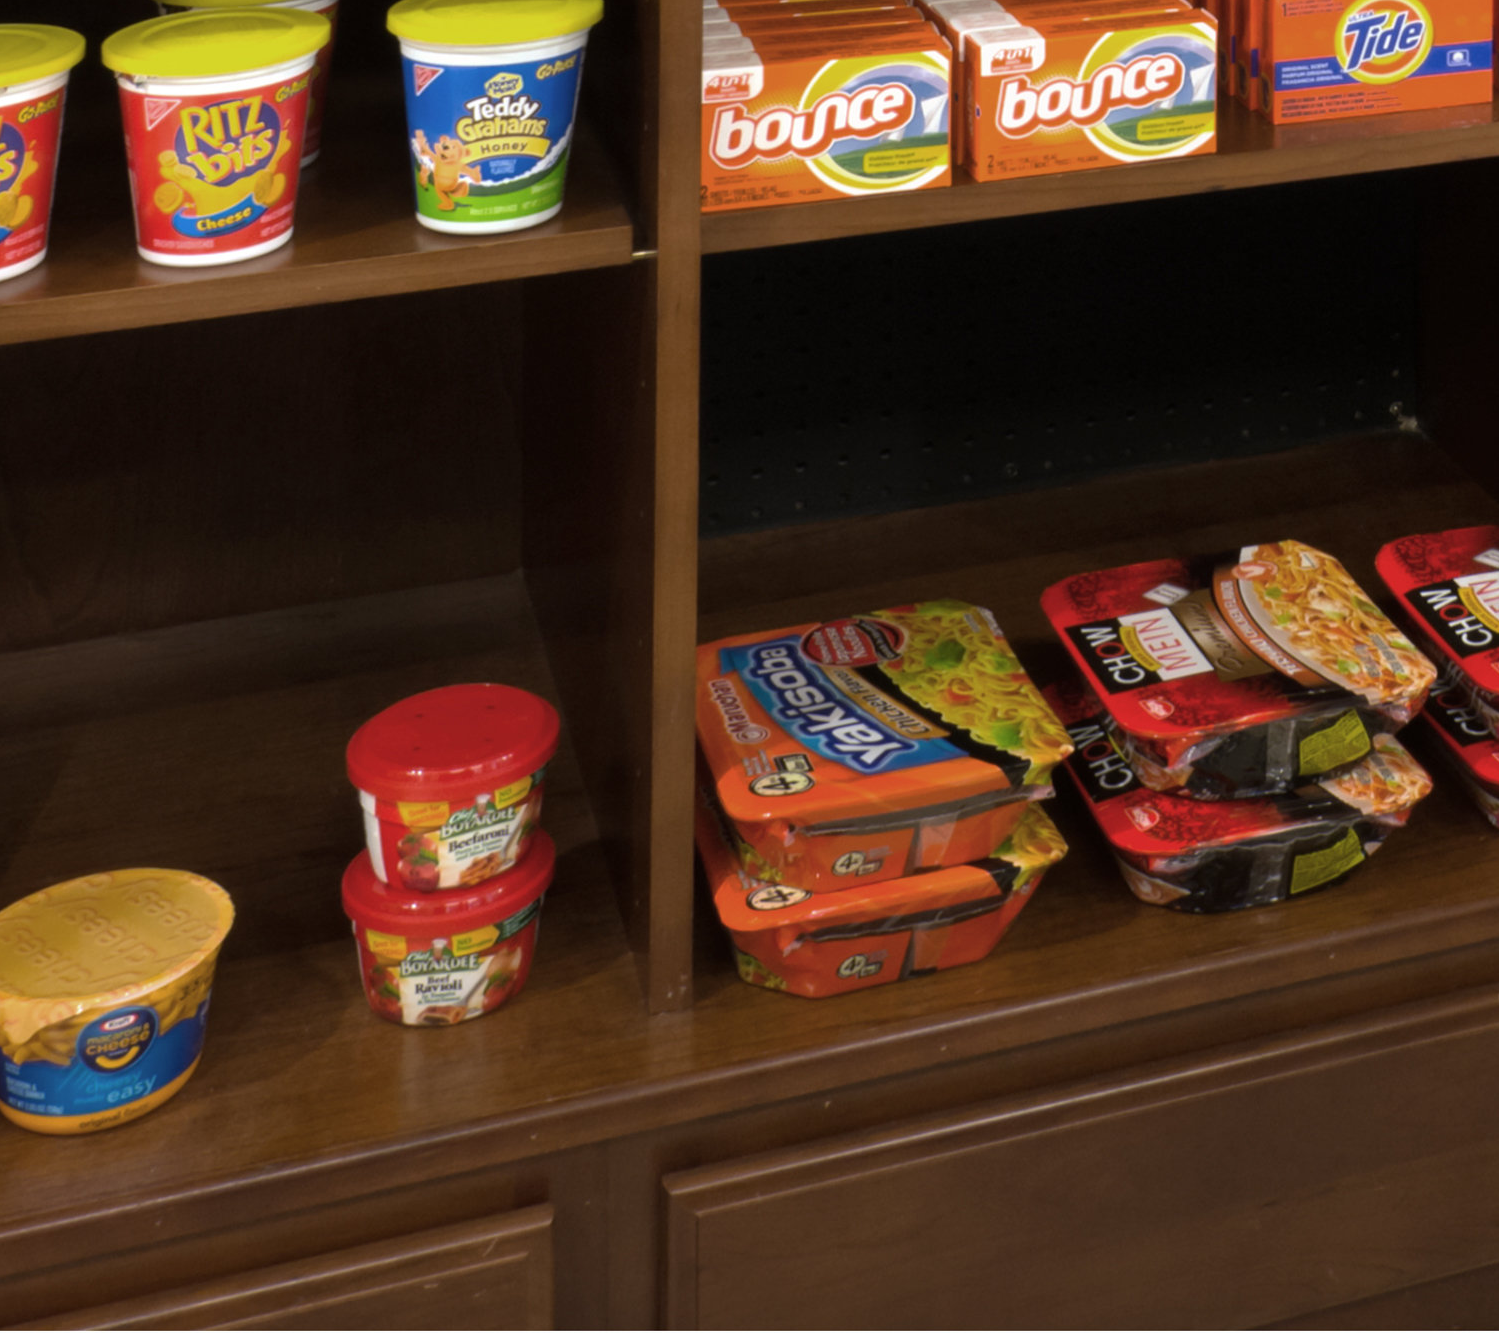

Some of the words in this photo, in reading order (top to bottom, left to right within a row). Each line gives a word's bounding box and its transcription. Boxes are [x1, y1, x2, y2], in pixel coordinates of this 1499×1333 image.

[1341, 11, 1426, 74] Tide
[466, 95, 540, 122] Teddy
[1001, 56, 1182, 135] bounce
[455, 116, 548, 143] Grahams
[714, 85, 913, 167] bounce
[479, 141, 530, 155] Honey
[1079, 626, 1146, 685] CHOW
[1133, 615, 1198, 672] MEIN
[759, 644, 905, 766] Yakisoba
[448, 825, 511, 853] Beefaroni
[402, 954, 480, 975] BOYARDEE
[414, 980, 463, 995] Ravioli
[105, 1073, 159, 1104] easy
